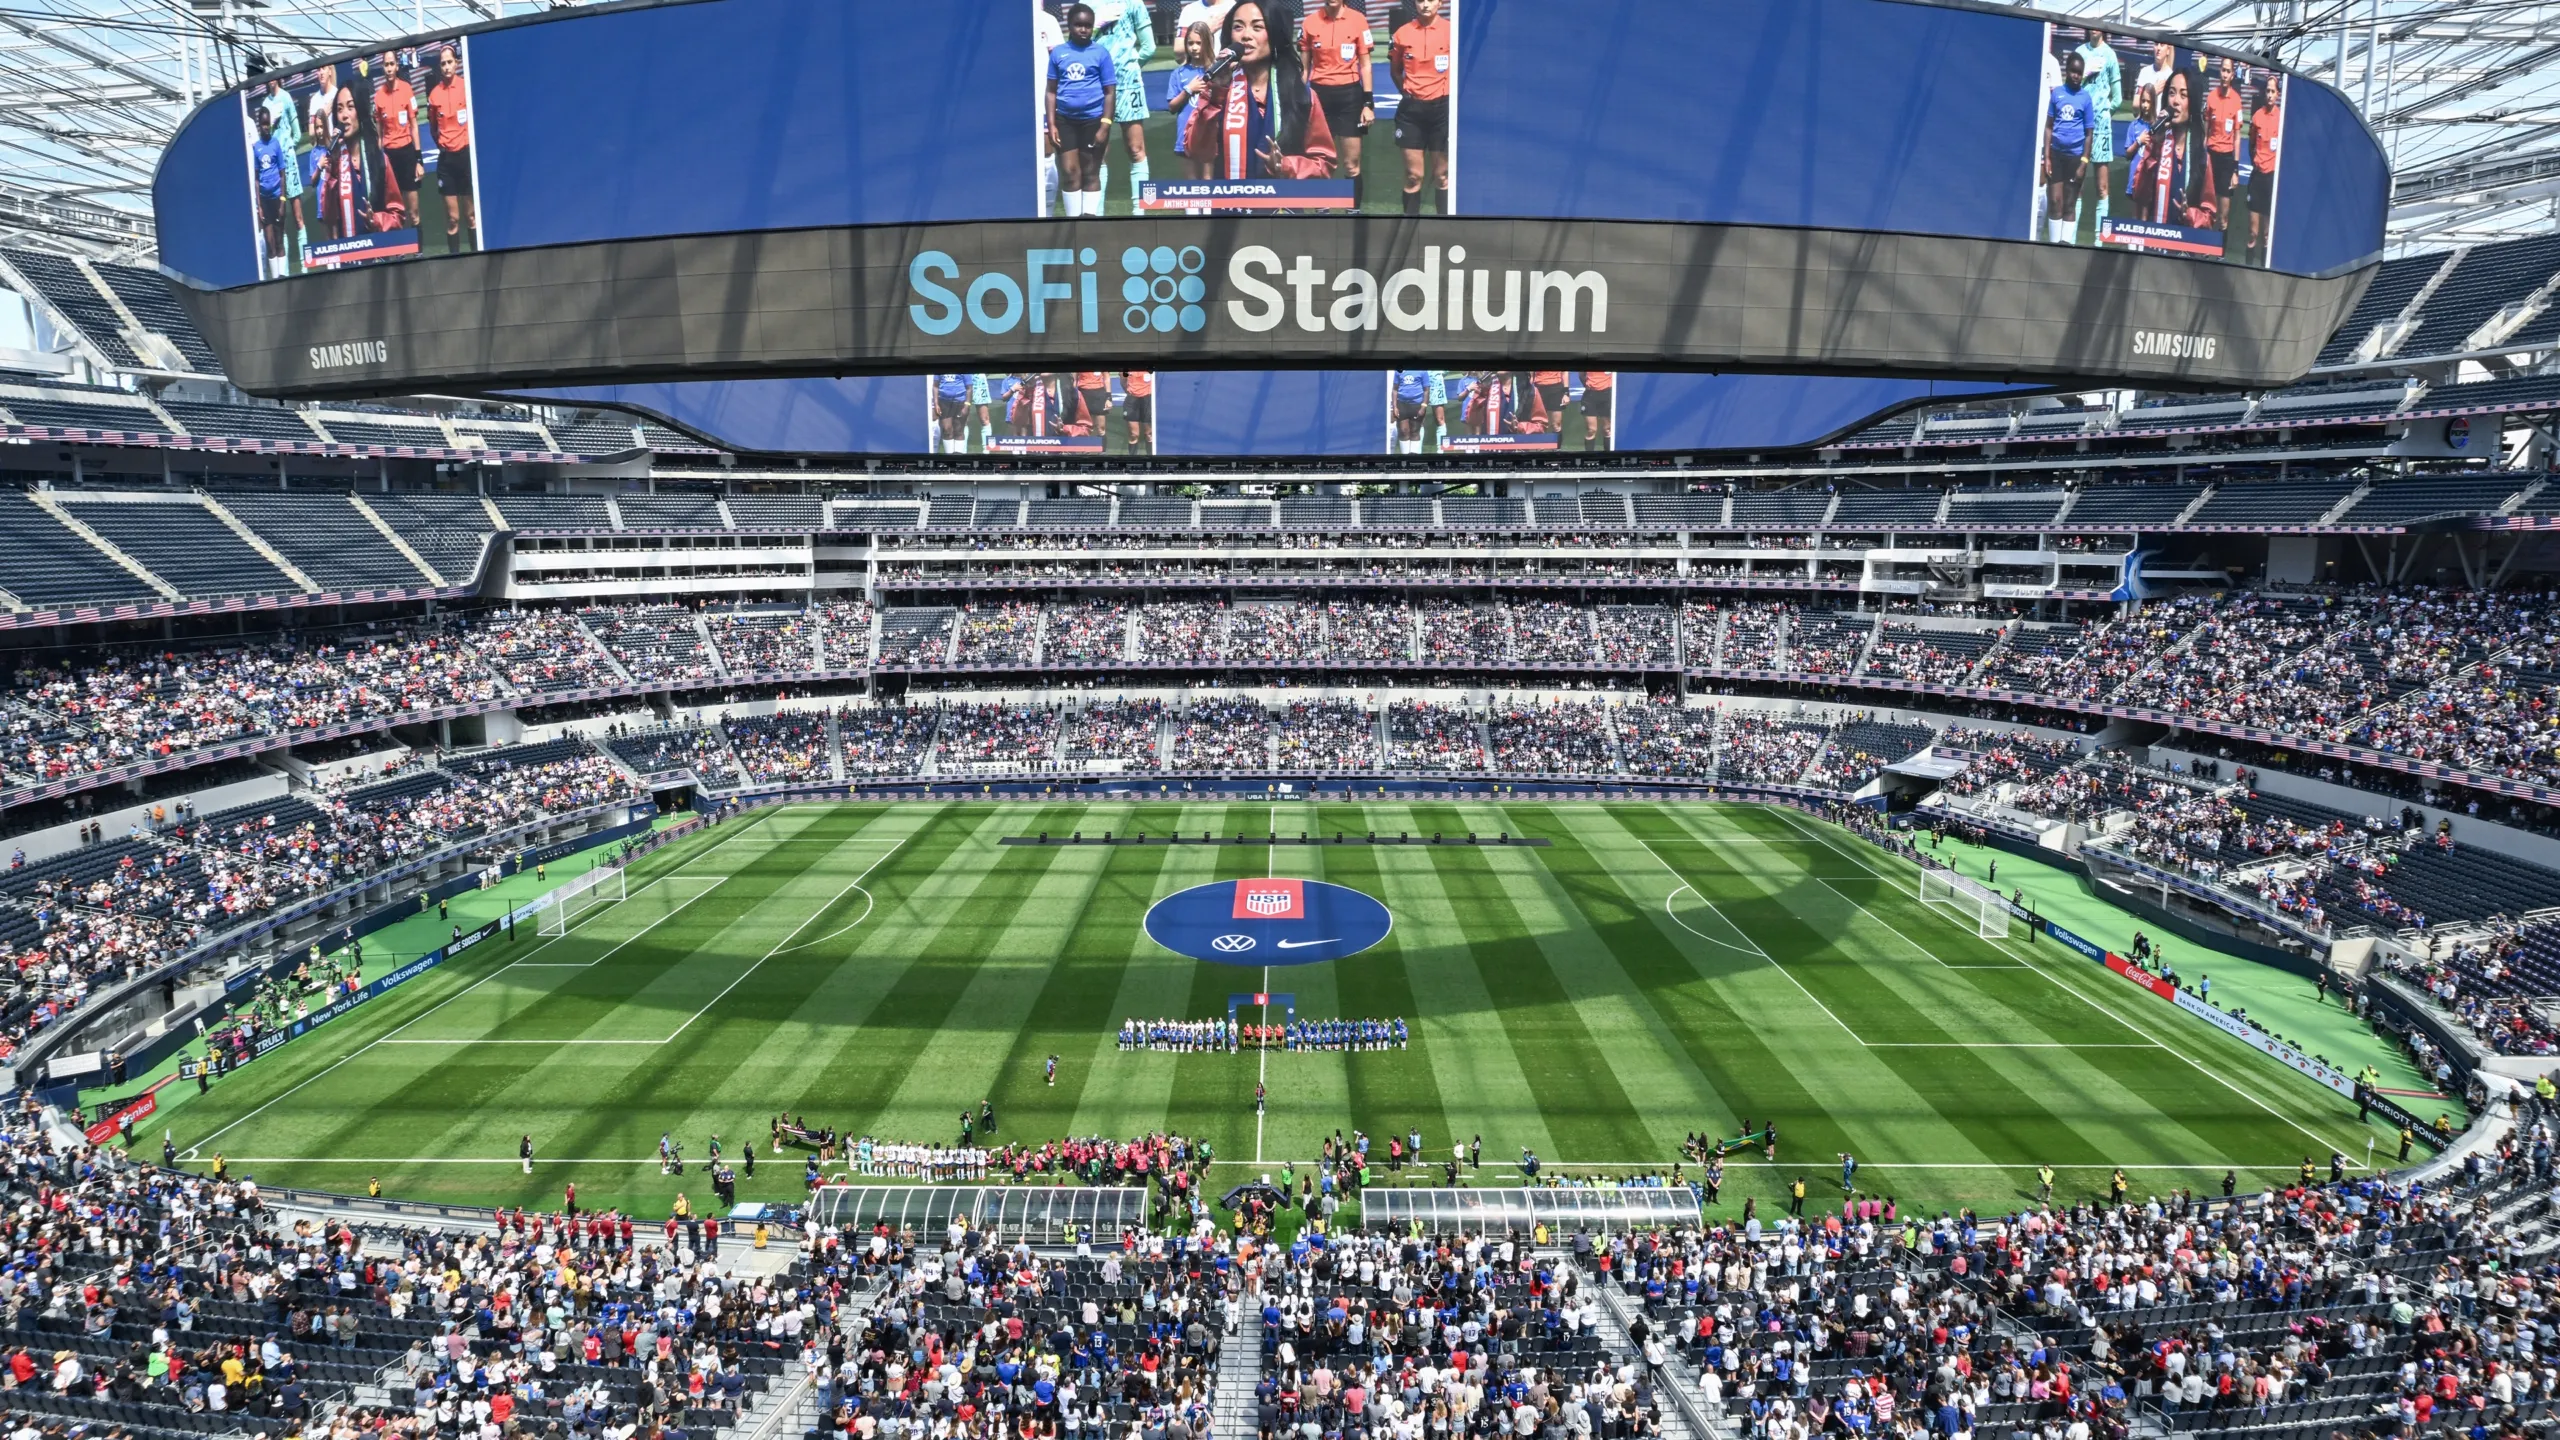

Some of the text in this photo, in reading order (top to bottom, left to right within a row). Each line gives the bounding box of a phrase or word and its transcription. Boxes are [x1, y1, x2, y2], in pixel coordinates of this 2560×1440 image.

[1130, 91, 1143, 108] 21
[1163, 184, 1277, 196] JULES AURORA
[1163, 199, 1213, 208] ANTHEM SINGER
[2115, 223, 2182, 239] JULES AURORA
[314, 239, 374, 255] JULES AURORA
[909, 245, 1607, 335] SoFi Stadium
[309, 340, 387, 369] SAMSUNG
[2133, 330, 2216, 360] SAMSUNG
[447, 931, 482, 956] NIKE SOCCER
[2054, 926, 2098, 957] Volkswagen
[381, 957, 433, 988] Volkswagen
[311, 991, 369, 1026] New York Life
[2178, 997, 2235, 1031] BANK OF AMERICA
[255, 1030, 285, 1052] TRULY
[2370, 1099, 2449, 1150] ARRIOTT BONVOY
[1094, 1338, 1102, 1348] 13
[1843, 1406, 1851, 1416] 19
